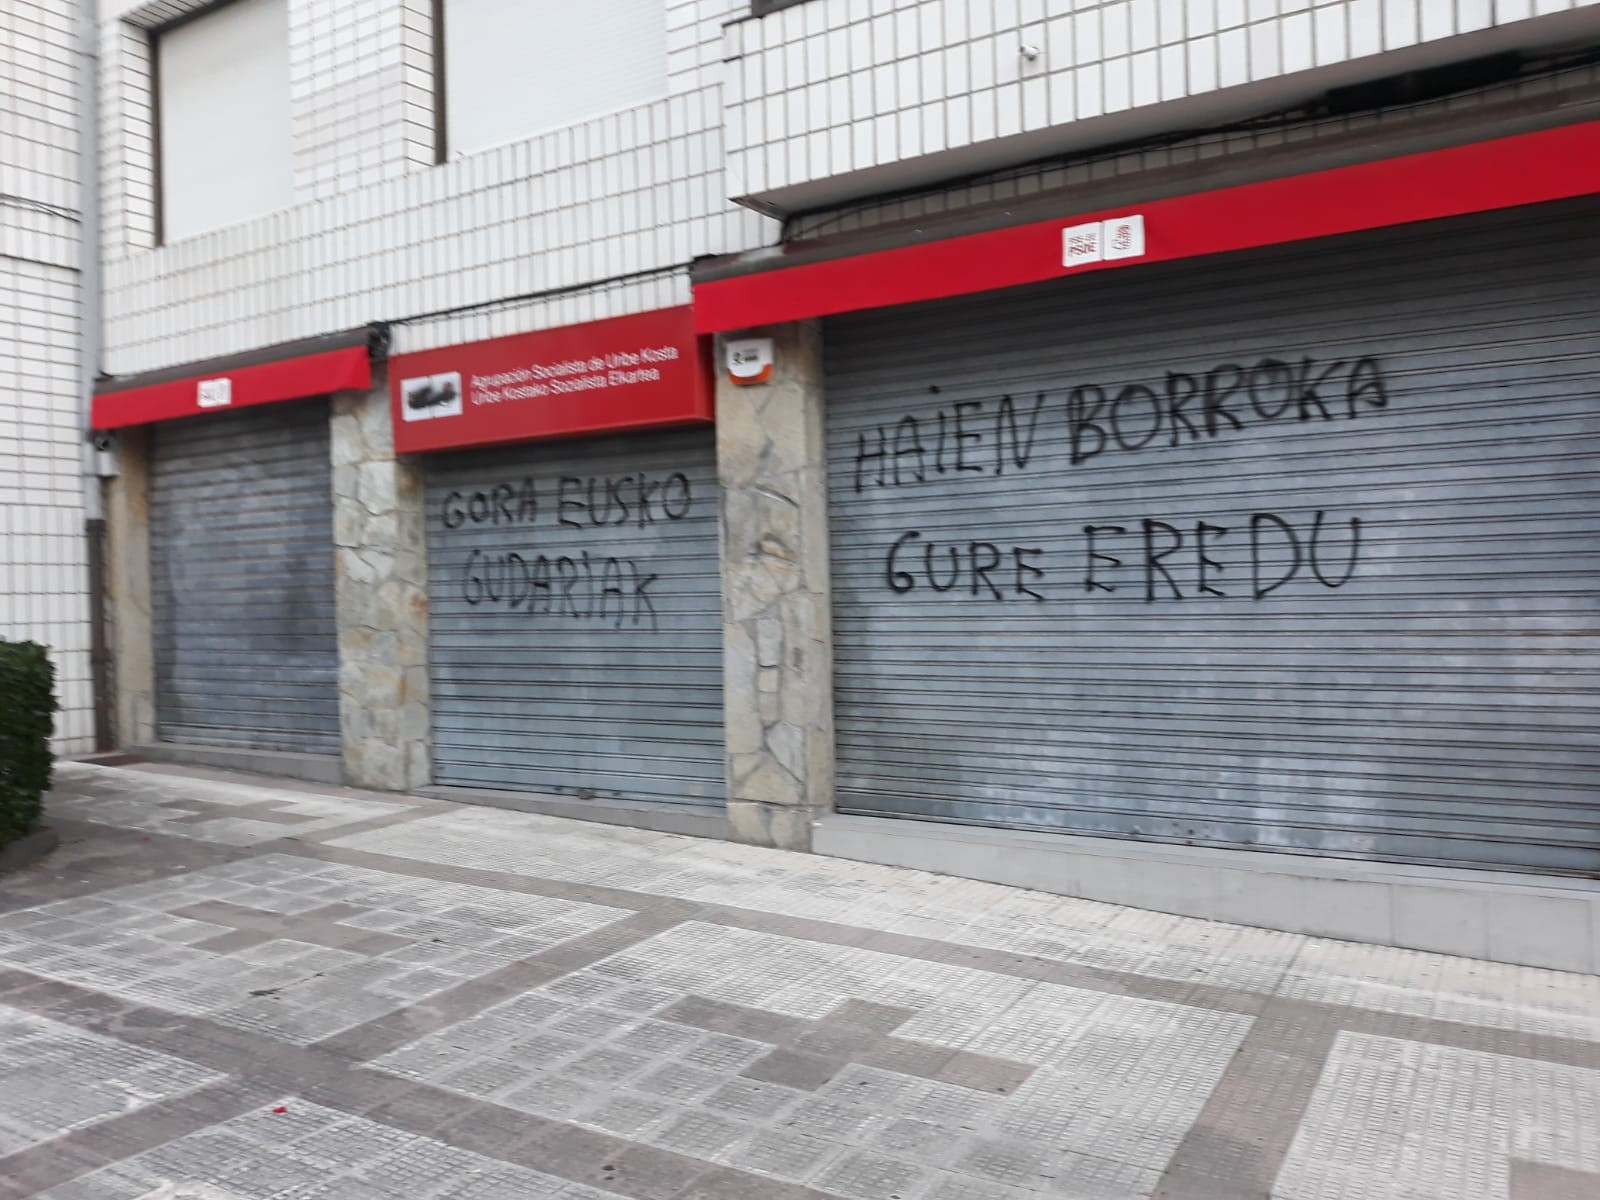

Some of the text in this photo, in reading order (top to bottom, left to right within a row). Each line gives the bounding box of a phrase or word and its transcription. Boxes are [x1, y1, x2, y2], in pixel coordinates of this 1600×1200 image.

[471, 391, 502, 406] Uribe
[609, 367, 660, 387] Elkartea
[533, 361, 588, 380] Socialista
[588, 356, 605, 373] de
[606, 351, 640, 369] Uribe
[641, 346, 679, 363] Kosta
[1067, 356, 1389, 467] BORROKA
[441, 471, 692, 530] GORA EUSKO
[462, 548, 659, 633] GUDARIAK
[886, 510, 1361, 601] GURE EREDU
